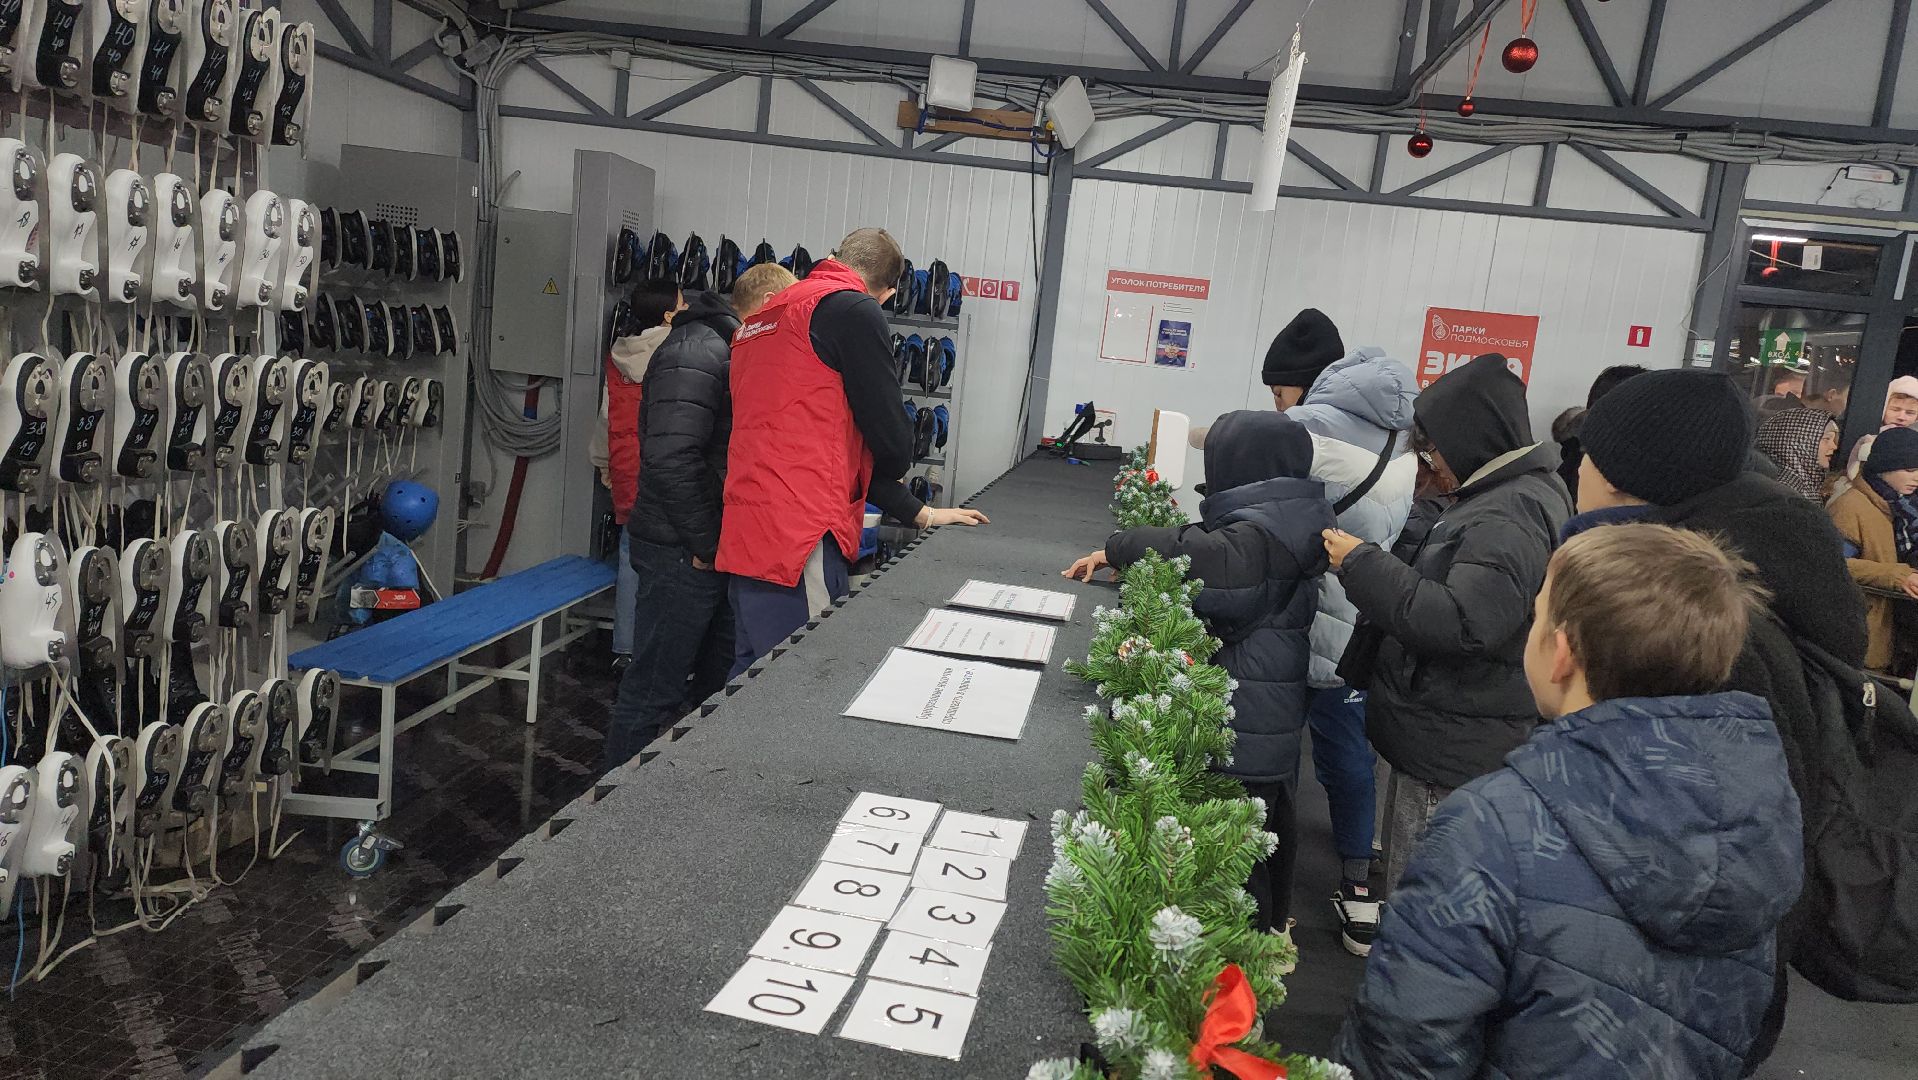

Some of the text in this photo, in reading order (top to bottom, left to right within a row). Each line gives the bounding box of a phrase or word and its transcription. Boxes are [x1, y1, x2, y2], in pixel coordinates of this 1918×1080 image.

[53, 10, 73, 32] 40
[115, 22, 135, 46] 40
[153, 40, 171, 58] 41
[211, 49, 226, 69] 41
[151, 65, 163, 80] 41
[203, 72, 216, 93] 41
[1111, 277, 1206, 293] УГОЛОК ПОТРЕБИТЕЛЯ
[1452, 325, 1486, 335] ПАРКИ
[1450, 333, 1529, 349] ПОДМОСКОВЬЯ
[1767, 350, 1791, 360] ВХОД
[77, 415, 95, 431] 38
[221, 410, 239, 424] 38
[261, 409, 274, 422] 38
[300, 410, 316, 423] 38
[26, 421, 47, 435] 38
[20, 441, 36, 456] 19
[304, 553, 322, 566] 37
[45, 592, 58, 610] 45
[141, 594, 156, 607] 37
[152, 774, 168, 785] 36
[960, 830, 1003, 840] 1
[857, 840, 900, 856] 7
[941, 862, 987, 881] 2
[833, 879, 881, 897] 8
[927, 905, 976, 925] 3
[909, 947, 960, 968] 4
[748, 978, 818, 1016] 10
[886, 1003, 944, 1030] 5
